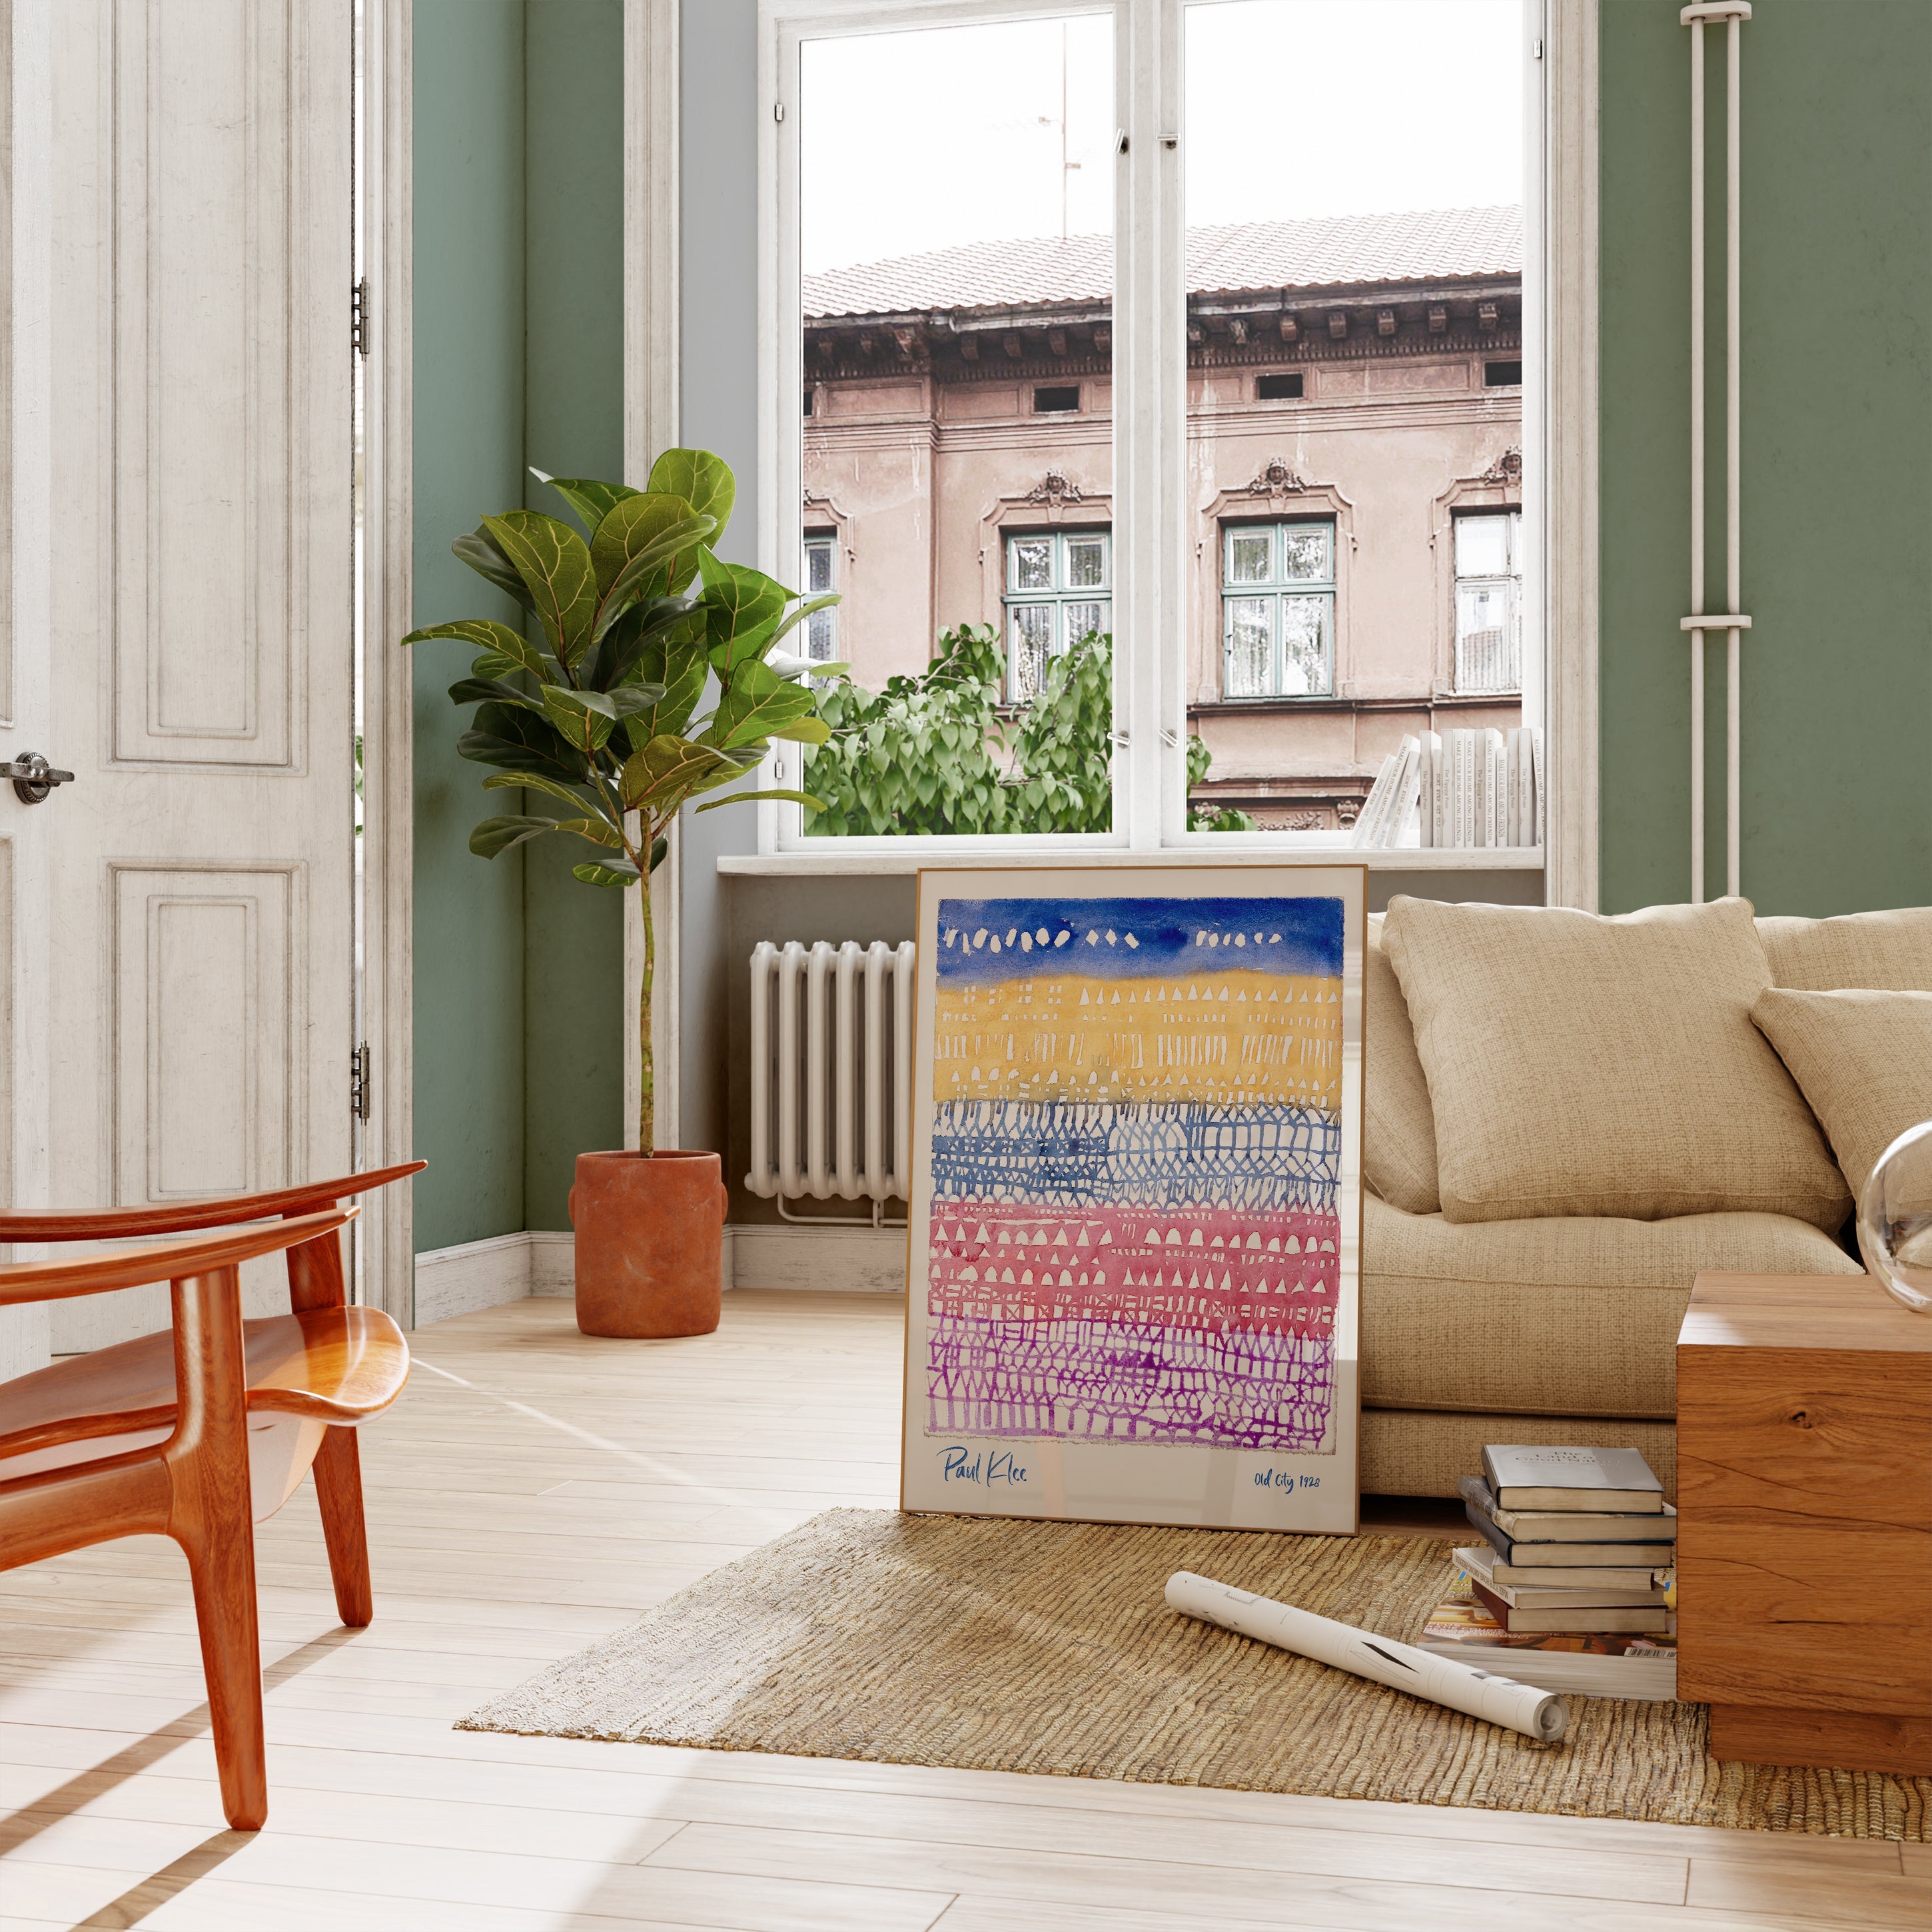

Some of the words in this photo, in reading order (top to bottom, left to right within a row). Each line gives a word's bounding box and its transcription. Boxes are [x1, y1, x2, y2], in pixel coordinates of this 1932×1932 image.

[1398, 745, 1407, 761] MAKE
[1392, 762, 1401, 779] YOUR
[1386, 779, 1396, 795] HOME
[1378, 795, 1388, 817] AMONG
[1370, 817, 1380, 841] FRIENDS
[936, 1446, 981, 1484] Paul
[987, 1451, 1027, 1488] Klee
[1255, 1468, 1272, 1488] Old
[1275, 1472, 1294, 1494] City
[1300, 1475, 1320, 1488] 1928
